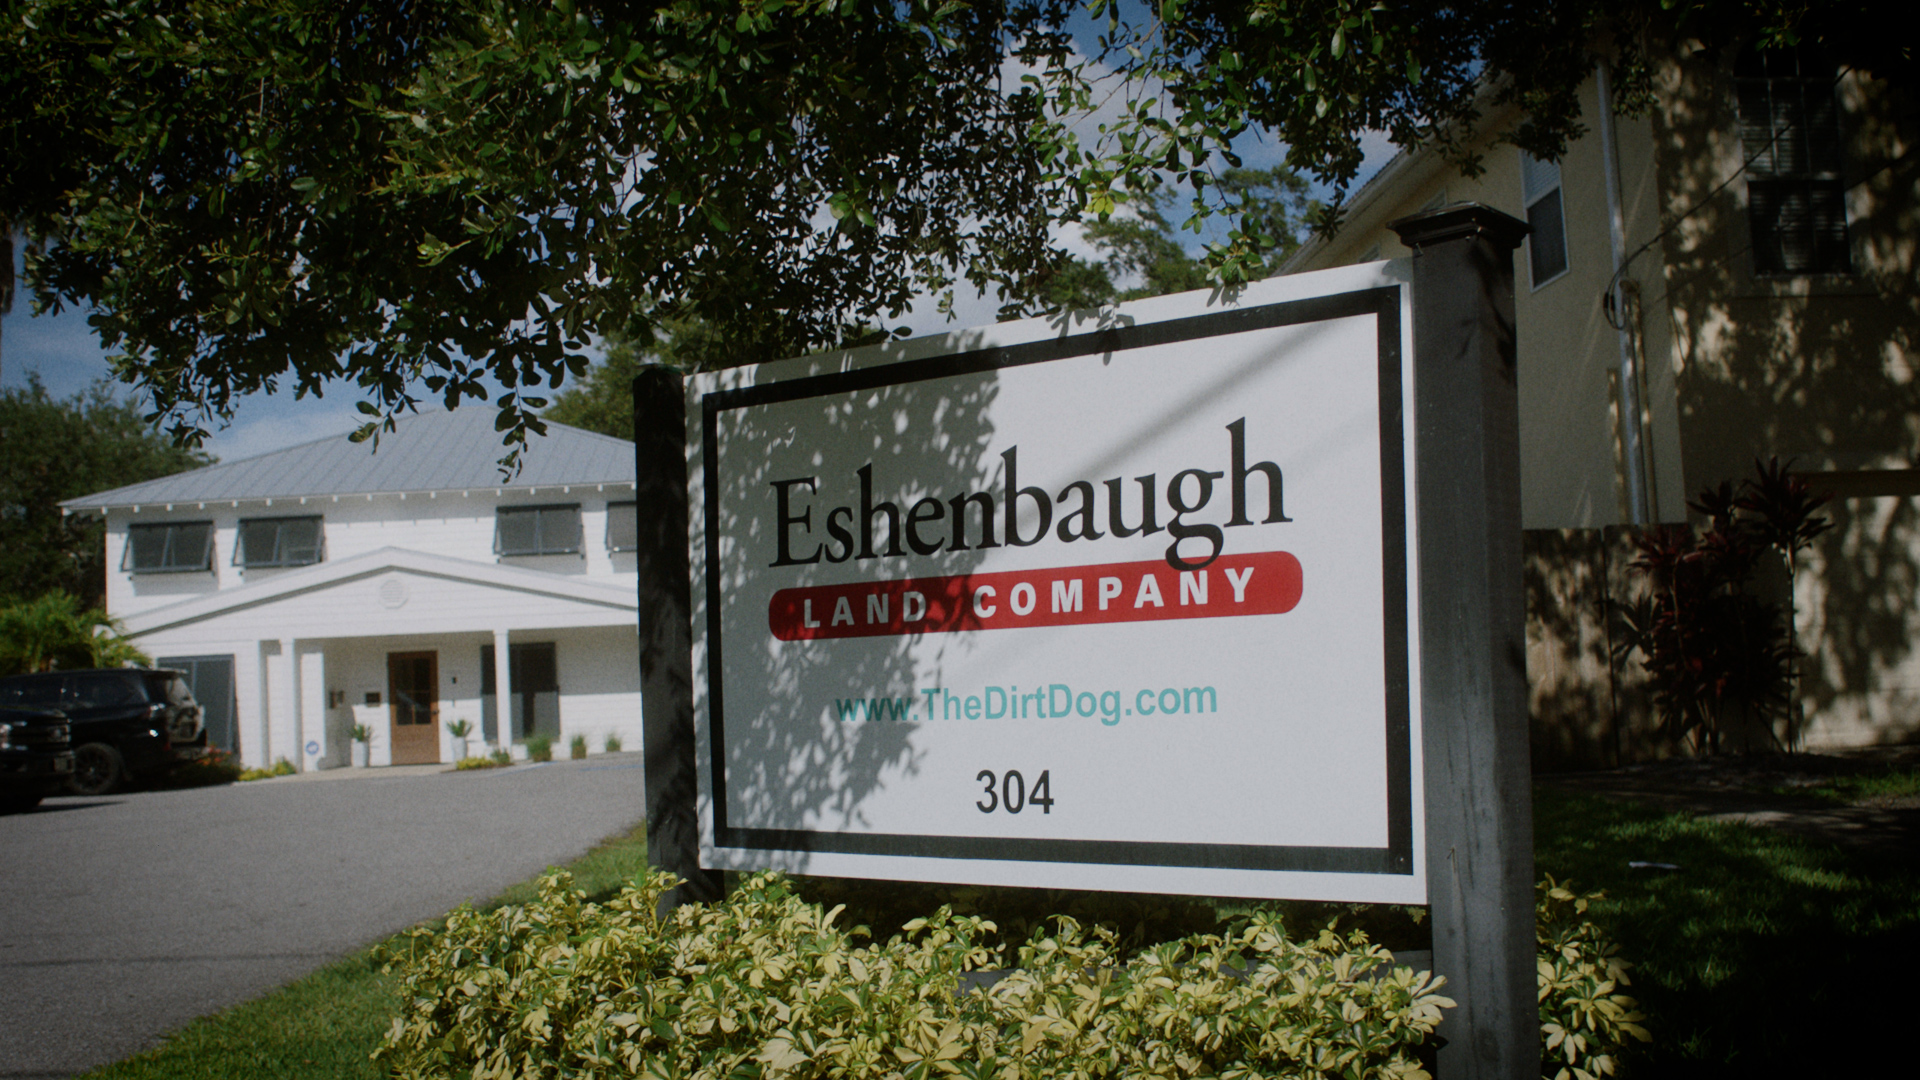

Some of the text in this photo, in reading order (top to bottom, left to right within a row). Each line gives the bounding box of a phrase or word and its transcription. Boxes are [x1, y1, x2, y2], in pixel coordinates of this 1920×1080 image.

[769, 417, 1293, 571] Eshenbaugh
[803, 567, 1256, 629] LAND COMPANY
[836, 684, 1218, 726] www.TheDirtDog.com
[975, 769, 1055, 815] 304
